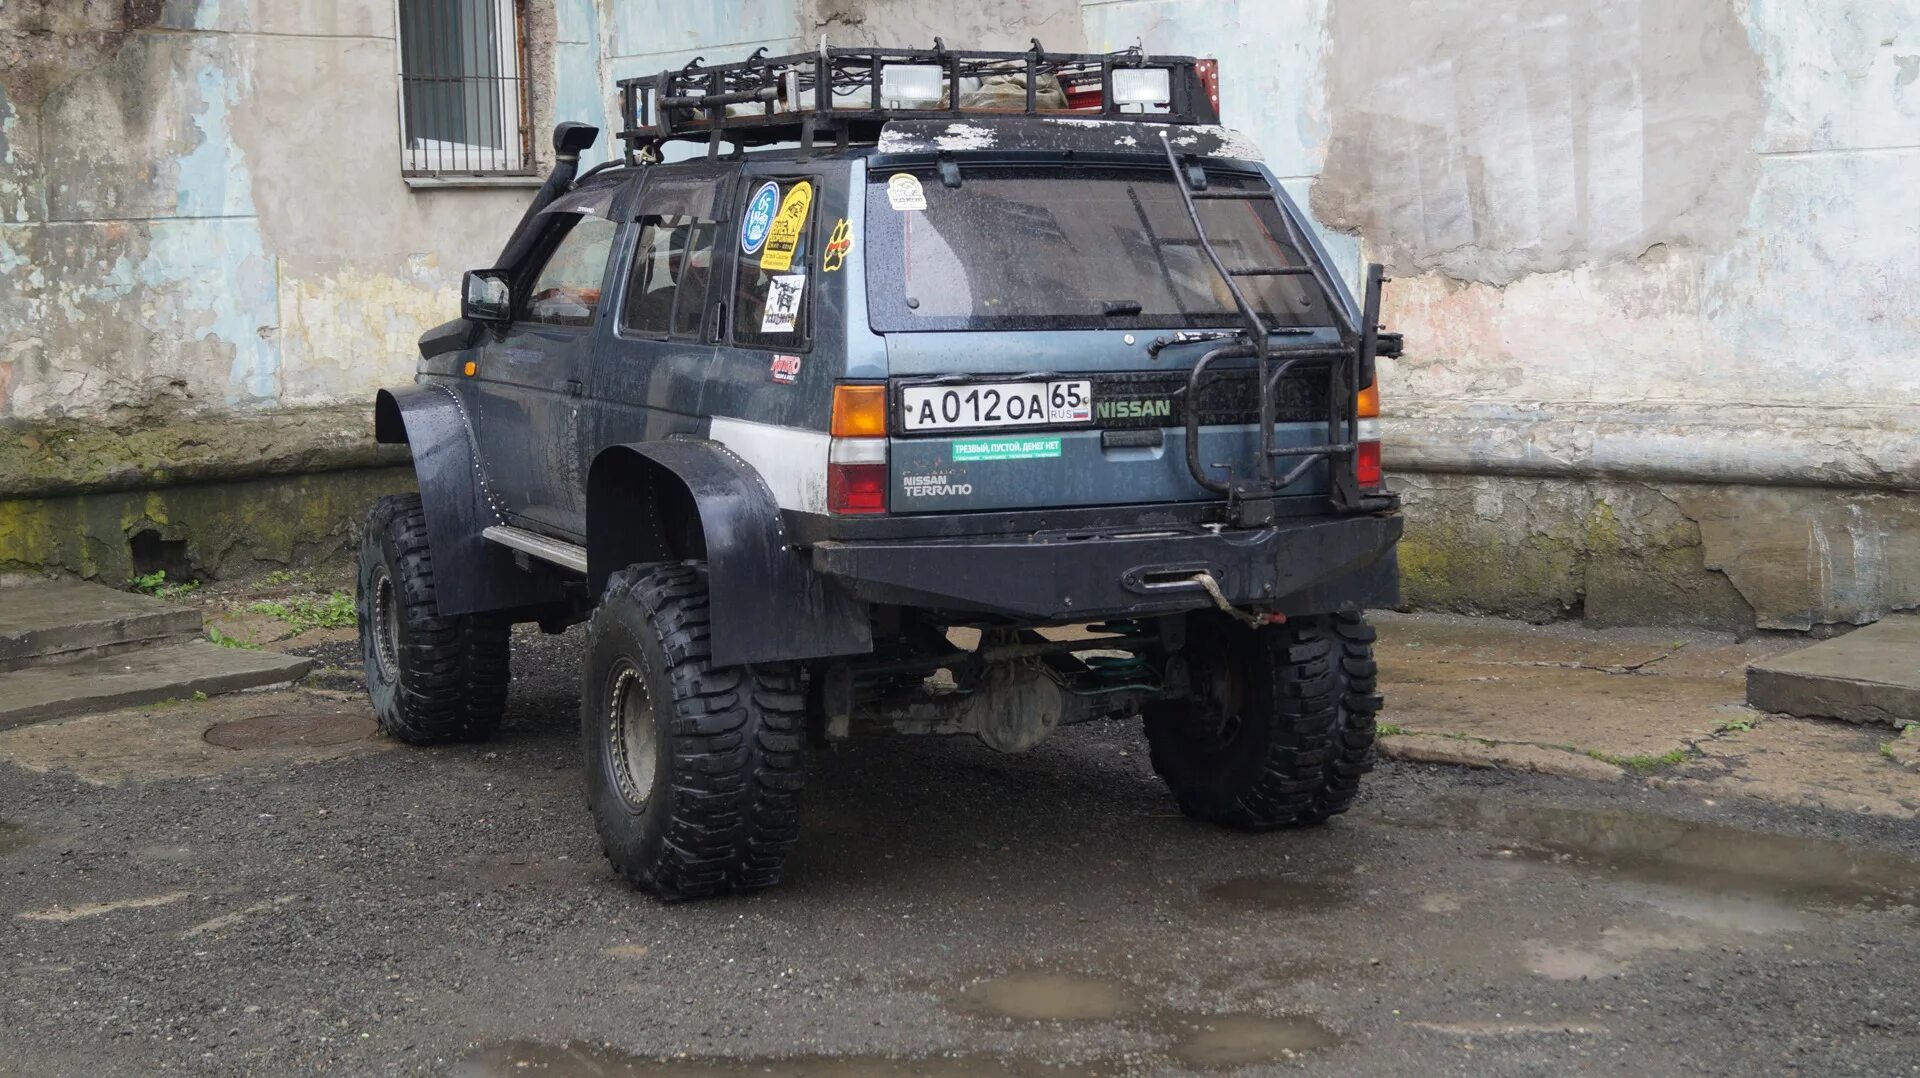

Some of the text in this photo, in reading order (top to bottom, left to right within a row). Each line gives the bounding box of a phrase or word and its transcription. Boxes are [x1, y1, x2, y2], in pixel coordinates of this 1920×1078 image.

[918, 383, 1081, 425] А012ОА 65
[1096, 400, 1171, 418] NISSAN
[1051, 409, 1072, 419] RUS
[955, 442, 990, 454] ТРЕЗВЫЙ,
[1022, 441, 1044, 452] ДЕНЕГ
[1045, 440, 1060, 450] НЕТ
[903, 475, 947, 486] NISSAN
[903, 483, 973, 497] TERRANO
